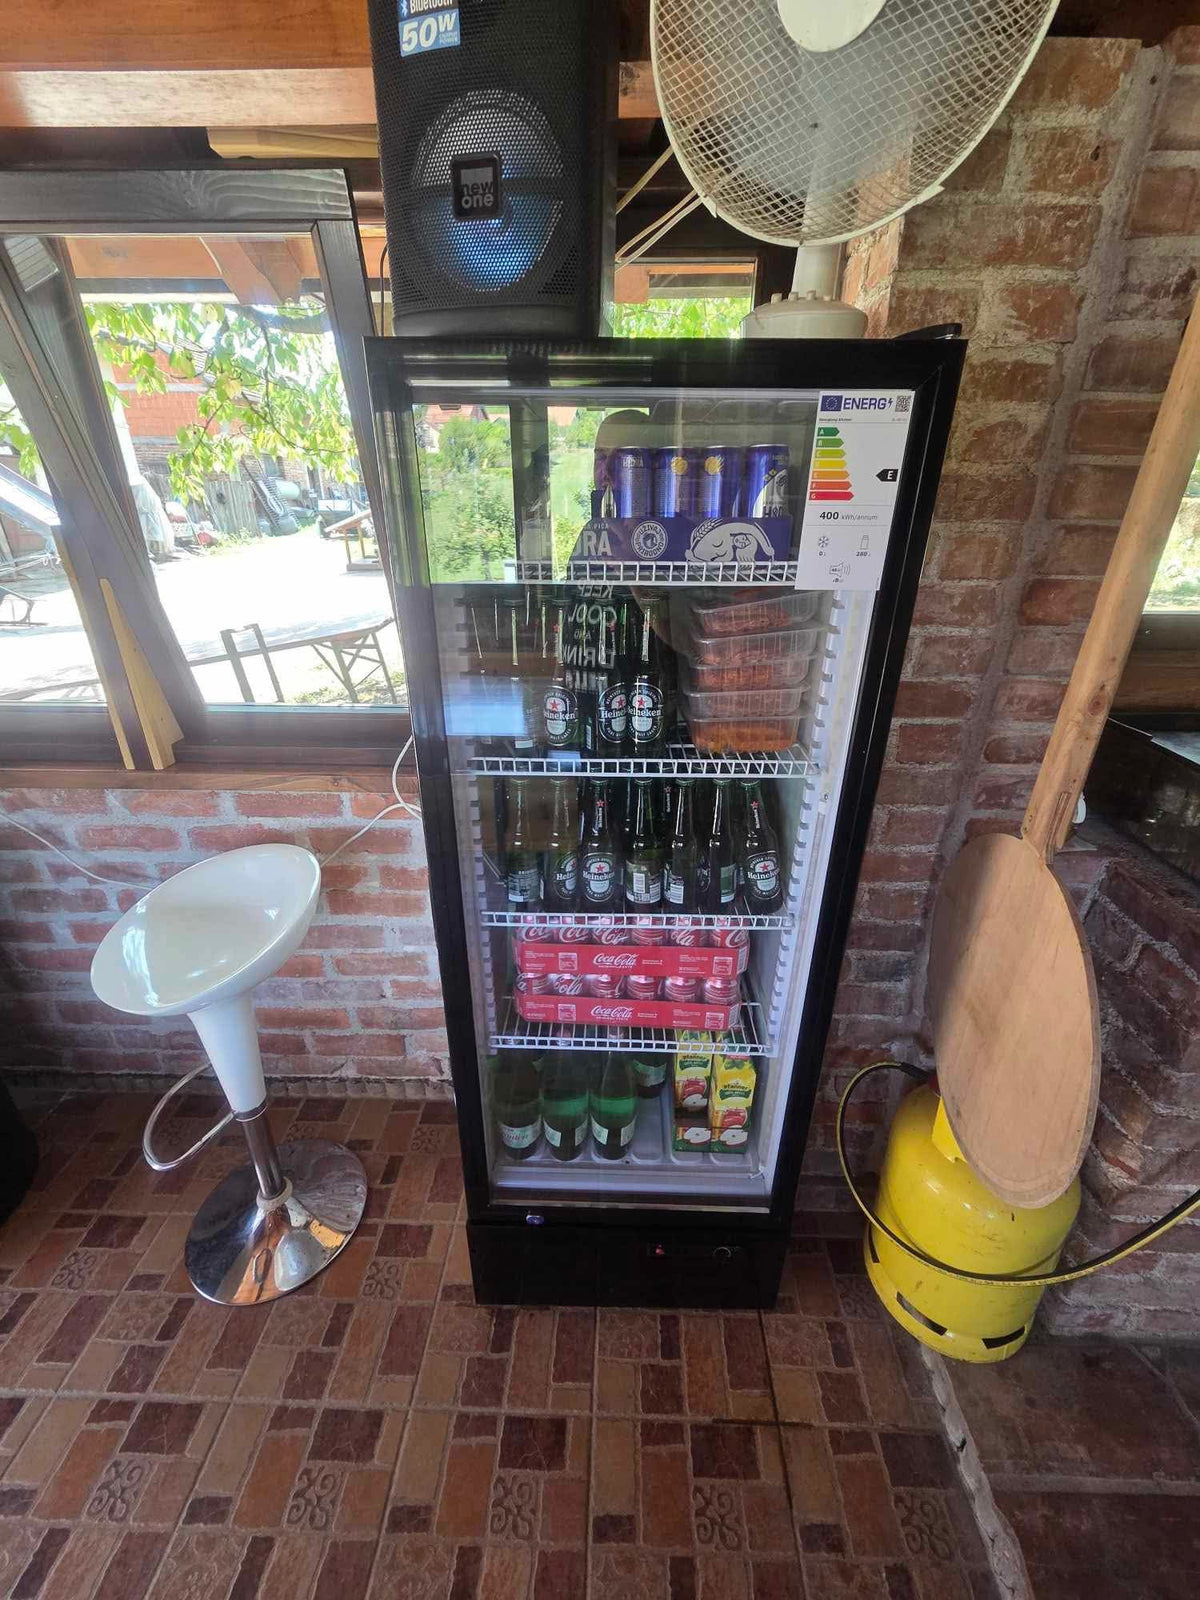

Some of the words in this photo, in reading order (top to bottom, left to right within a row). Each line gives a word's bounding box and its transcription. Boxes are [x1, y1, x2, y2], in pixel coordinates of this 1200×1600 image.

[461, 194, 494, 209] one
[887, 470, 894, 480] E
[819, 511, 839, 520] 400
